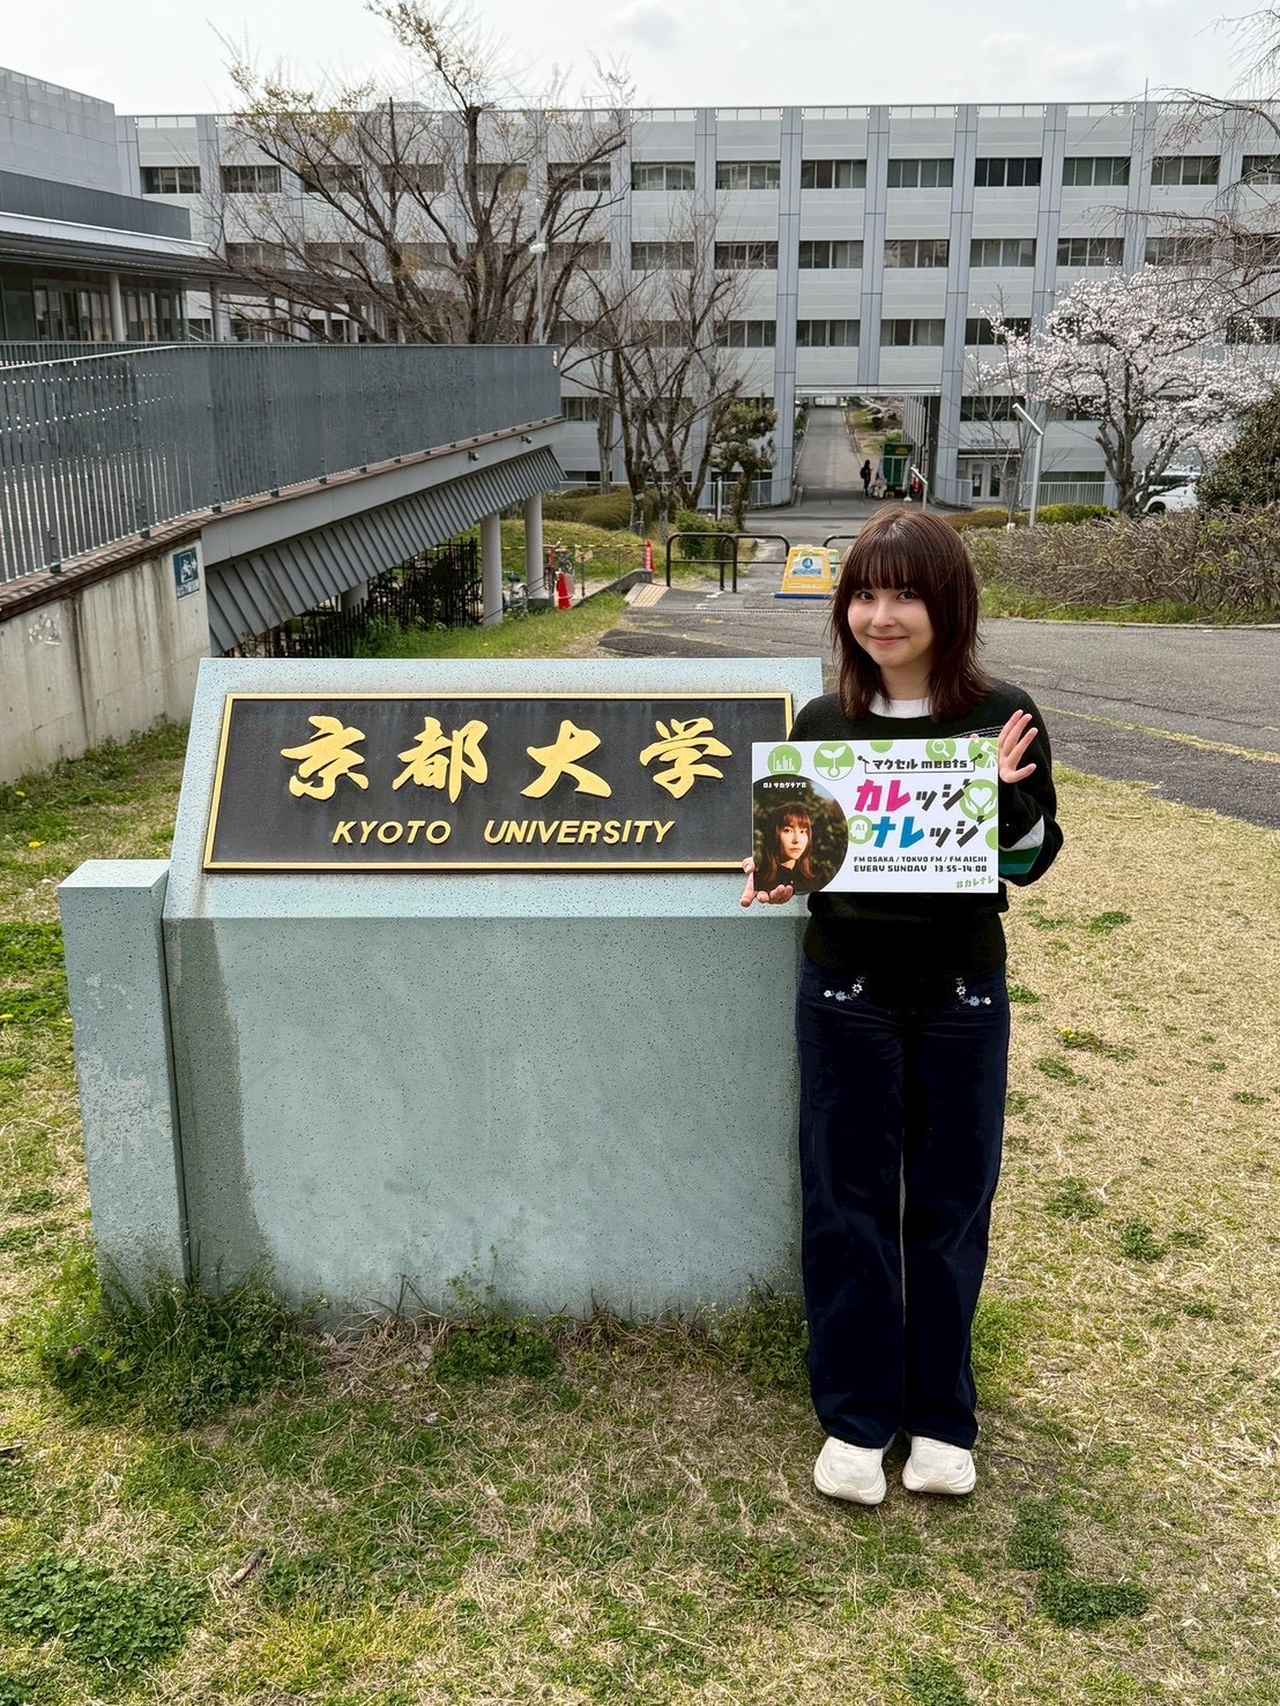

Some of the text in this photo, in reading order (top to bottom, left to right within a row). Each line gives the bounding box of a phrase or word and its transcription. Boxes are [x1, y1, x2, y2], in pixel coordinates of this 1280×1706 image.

[280, 715, 732, 803] 京都大学
[872, 758, 968, 770] マクセル meets
[854, 779, 972, 812] カレッジ
[332, 820, 675, 845] KYOTO UNIVERSITY
[871, 815, 985, 848] ナレッジ
[853, 855, 866, 863] FM
[867, 855, 895, 863] OSAKA
[930, 855, 943, 863] FM
[949, 855, 962, 863] FM
[963, 855, 988, 863] AICHI
